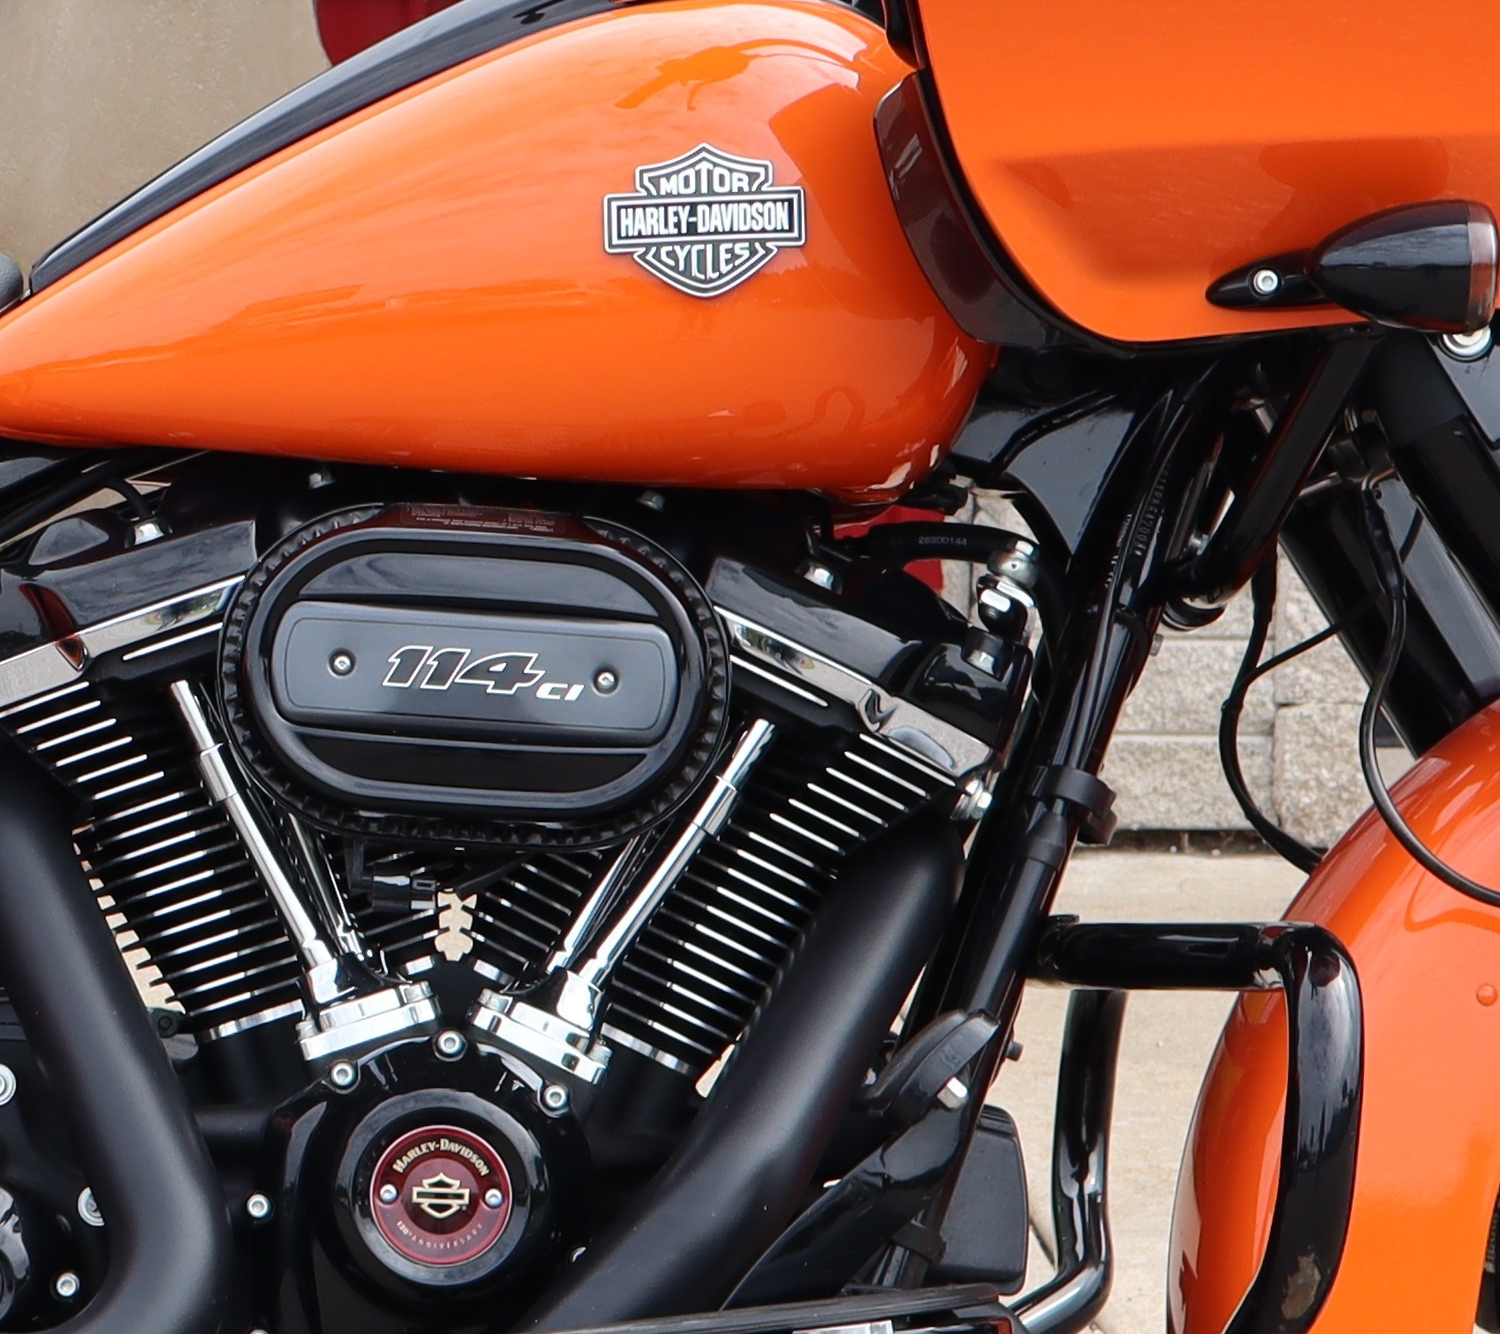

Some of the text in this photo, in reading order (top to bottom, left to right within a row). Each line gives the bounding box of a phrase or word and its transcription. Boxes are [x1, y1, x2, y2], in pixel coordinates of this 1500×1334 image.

[659, 162, 750, 196] MOTOR
[619, 201, 790, 238] HARLEY-DAVIDSON
[660, 243, 752, 281] CYCLES
[382, 644, 585, 701] 114 CI
[392, 1138, 490, 1177] HARLEY-DAVIDSON
